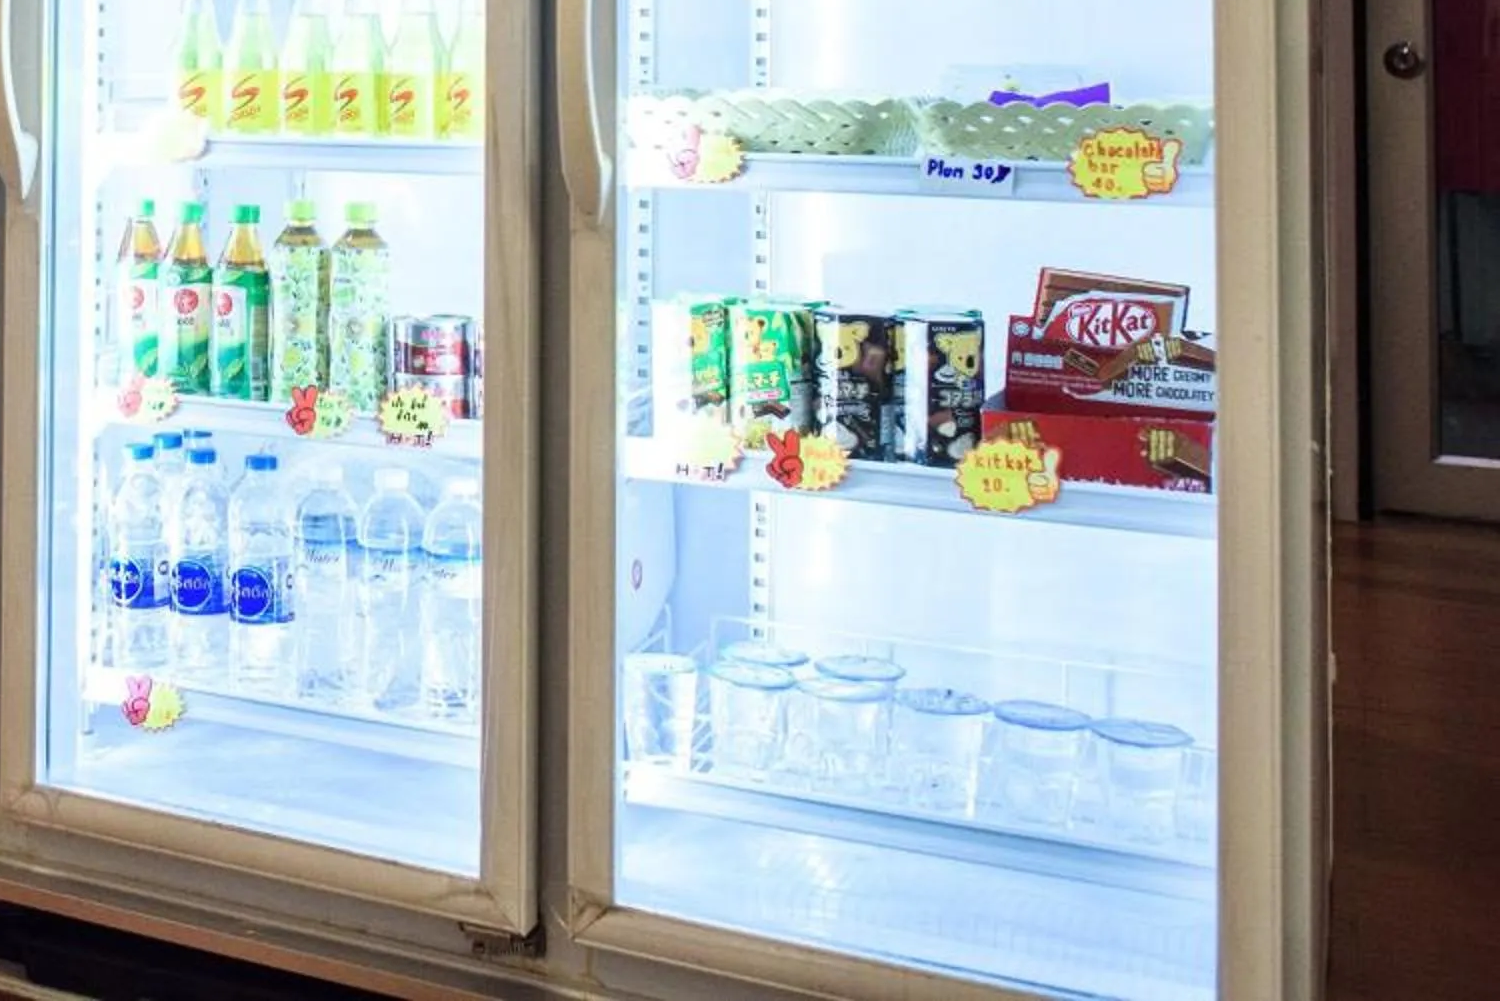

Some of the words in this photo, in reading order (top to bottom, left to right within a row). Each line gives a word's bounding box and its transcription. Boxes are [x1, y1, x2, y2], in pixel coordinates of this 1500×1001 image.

[1077, 301, 1150, 347] KitKat
[1128, 365, 1169, 383] MORE
[1113, 382, 1154, 399] MORE
[1155, 386, 1215, 402] CHOCOLATEY
